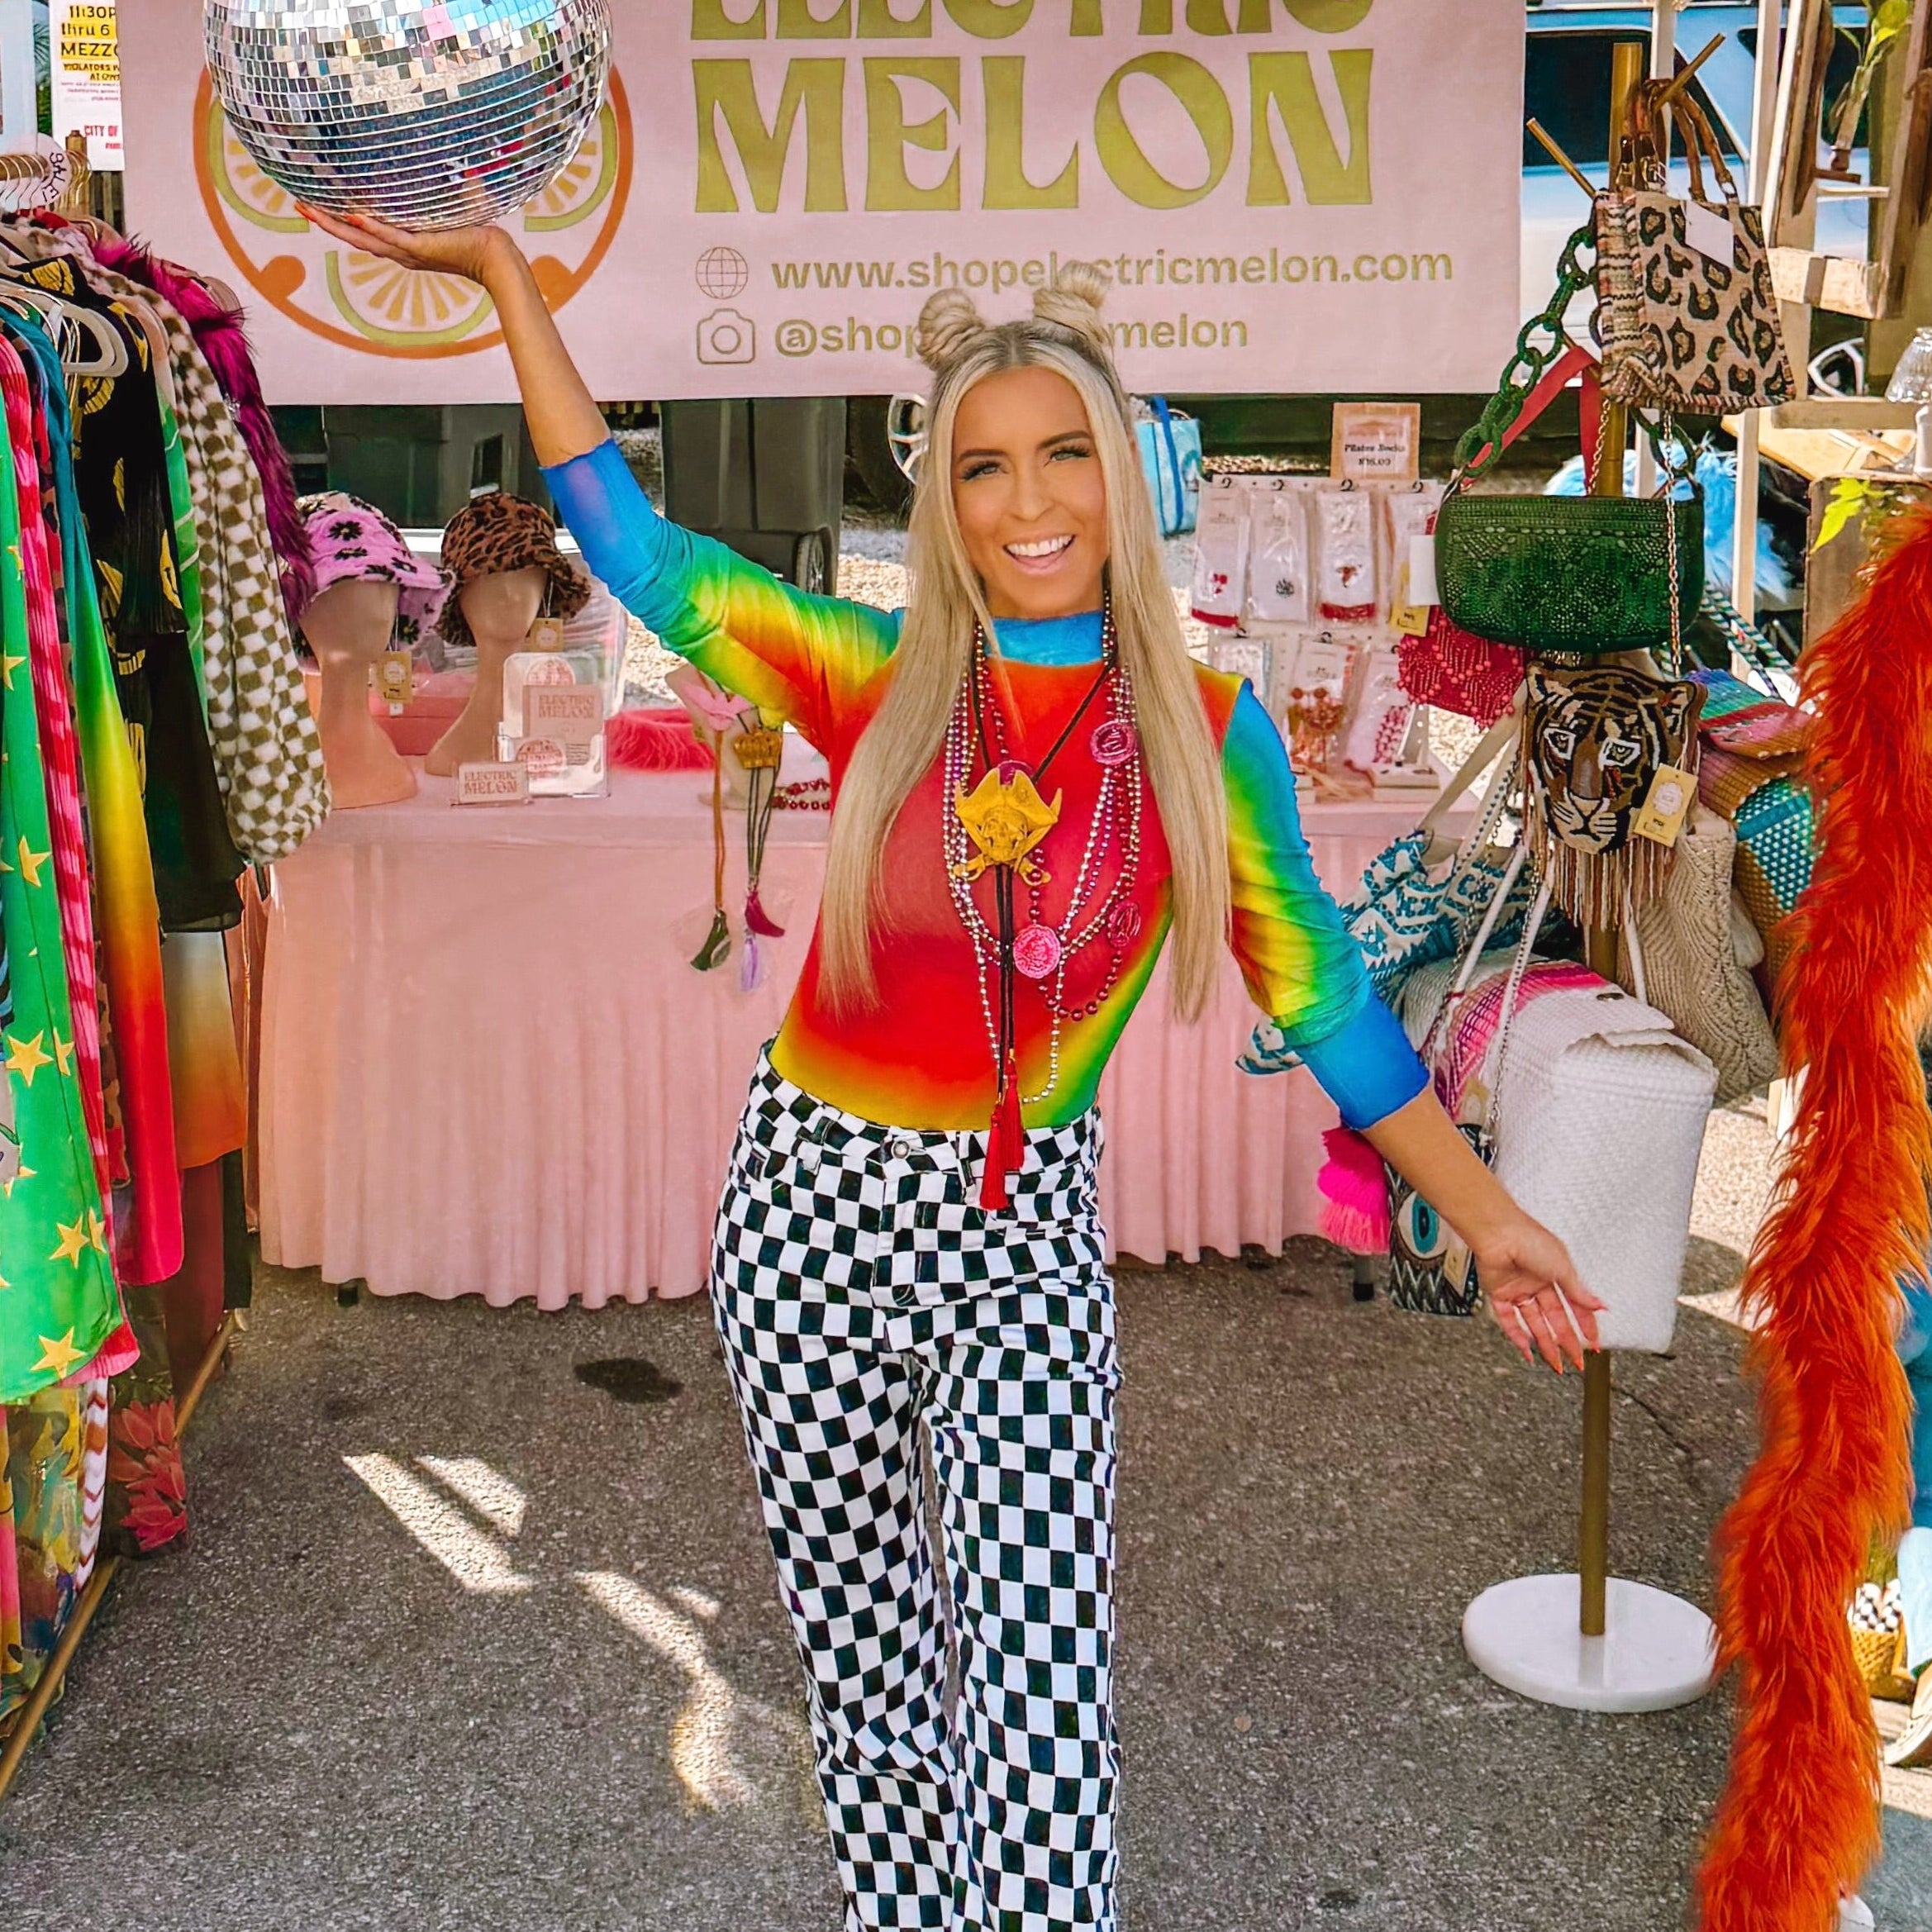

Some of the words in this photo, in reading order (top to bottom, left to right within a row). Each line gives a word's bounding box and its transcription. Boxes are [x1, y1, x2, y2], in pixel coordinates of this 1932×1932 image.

[100, 24, 110, 36] 6
[84, 126, 104, 136] CITY
[692, 49, 1373, 213] MELON
[464, 770, 516, 781] ELECTRIC
[464, 781, 517, 794] MELON
